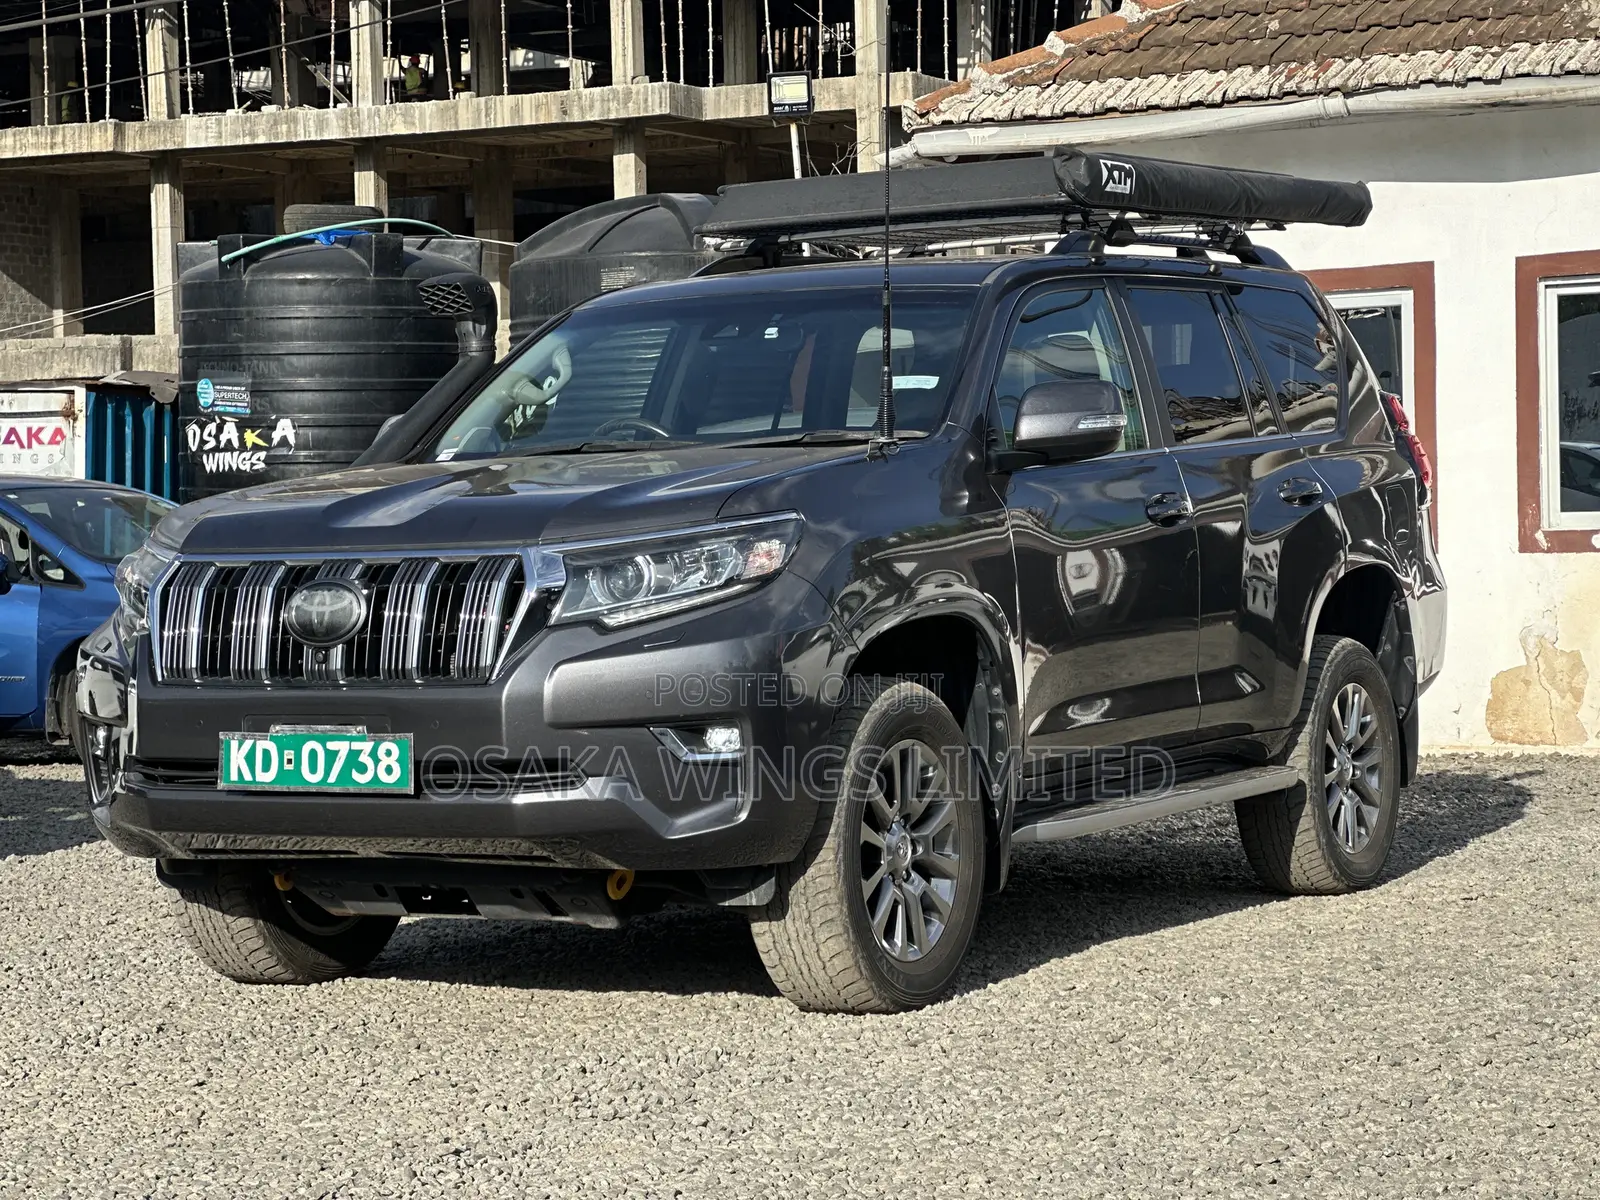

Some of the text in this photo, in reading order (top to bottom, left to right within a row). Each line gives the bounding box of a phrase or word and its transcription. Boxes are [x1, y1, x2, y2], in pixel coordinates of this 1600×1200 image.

[1100, 160, 1135, 194] XTM
[214, 391, 247, 400] SUPERTECH
[0, 426, 66, 449] AKA
[202, 451, 267, 474] WINGS
[230, 740, 401, 784] KD 0738
